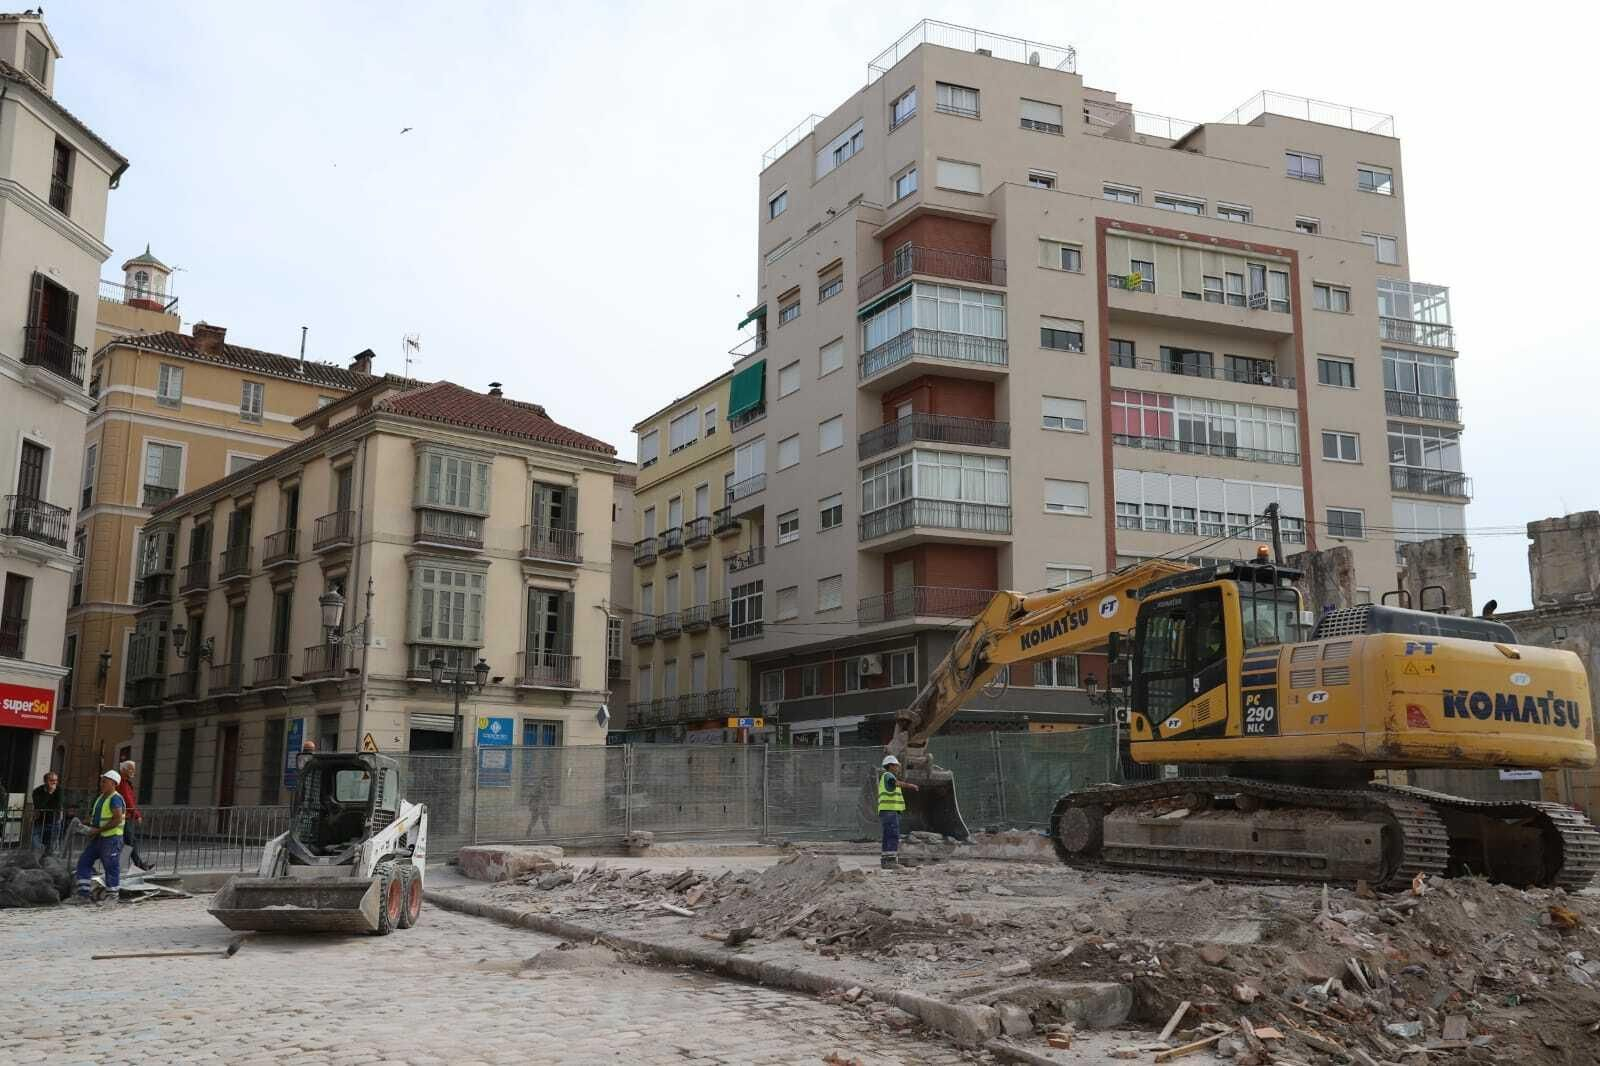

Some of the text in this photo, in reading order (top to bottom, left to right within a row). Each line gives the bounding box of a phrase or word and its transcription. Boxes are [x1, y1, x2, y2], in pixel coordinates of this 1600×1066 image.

[1020, 608, 1089, 651] KOMATSU
[2, 698, 49, 714] superSol
[1246, 694, 1261, 706] PC
[1246, 706, 1274, 722] 290
[1443, 689, 1580, 729] KOMATSU
[1247, 723, 1265, 733] NLC
